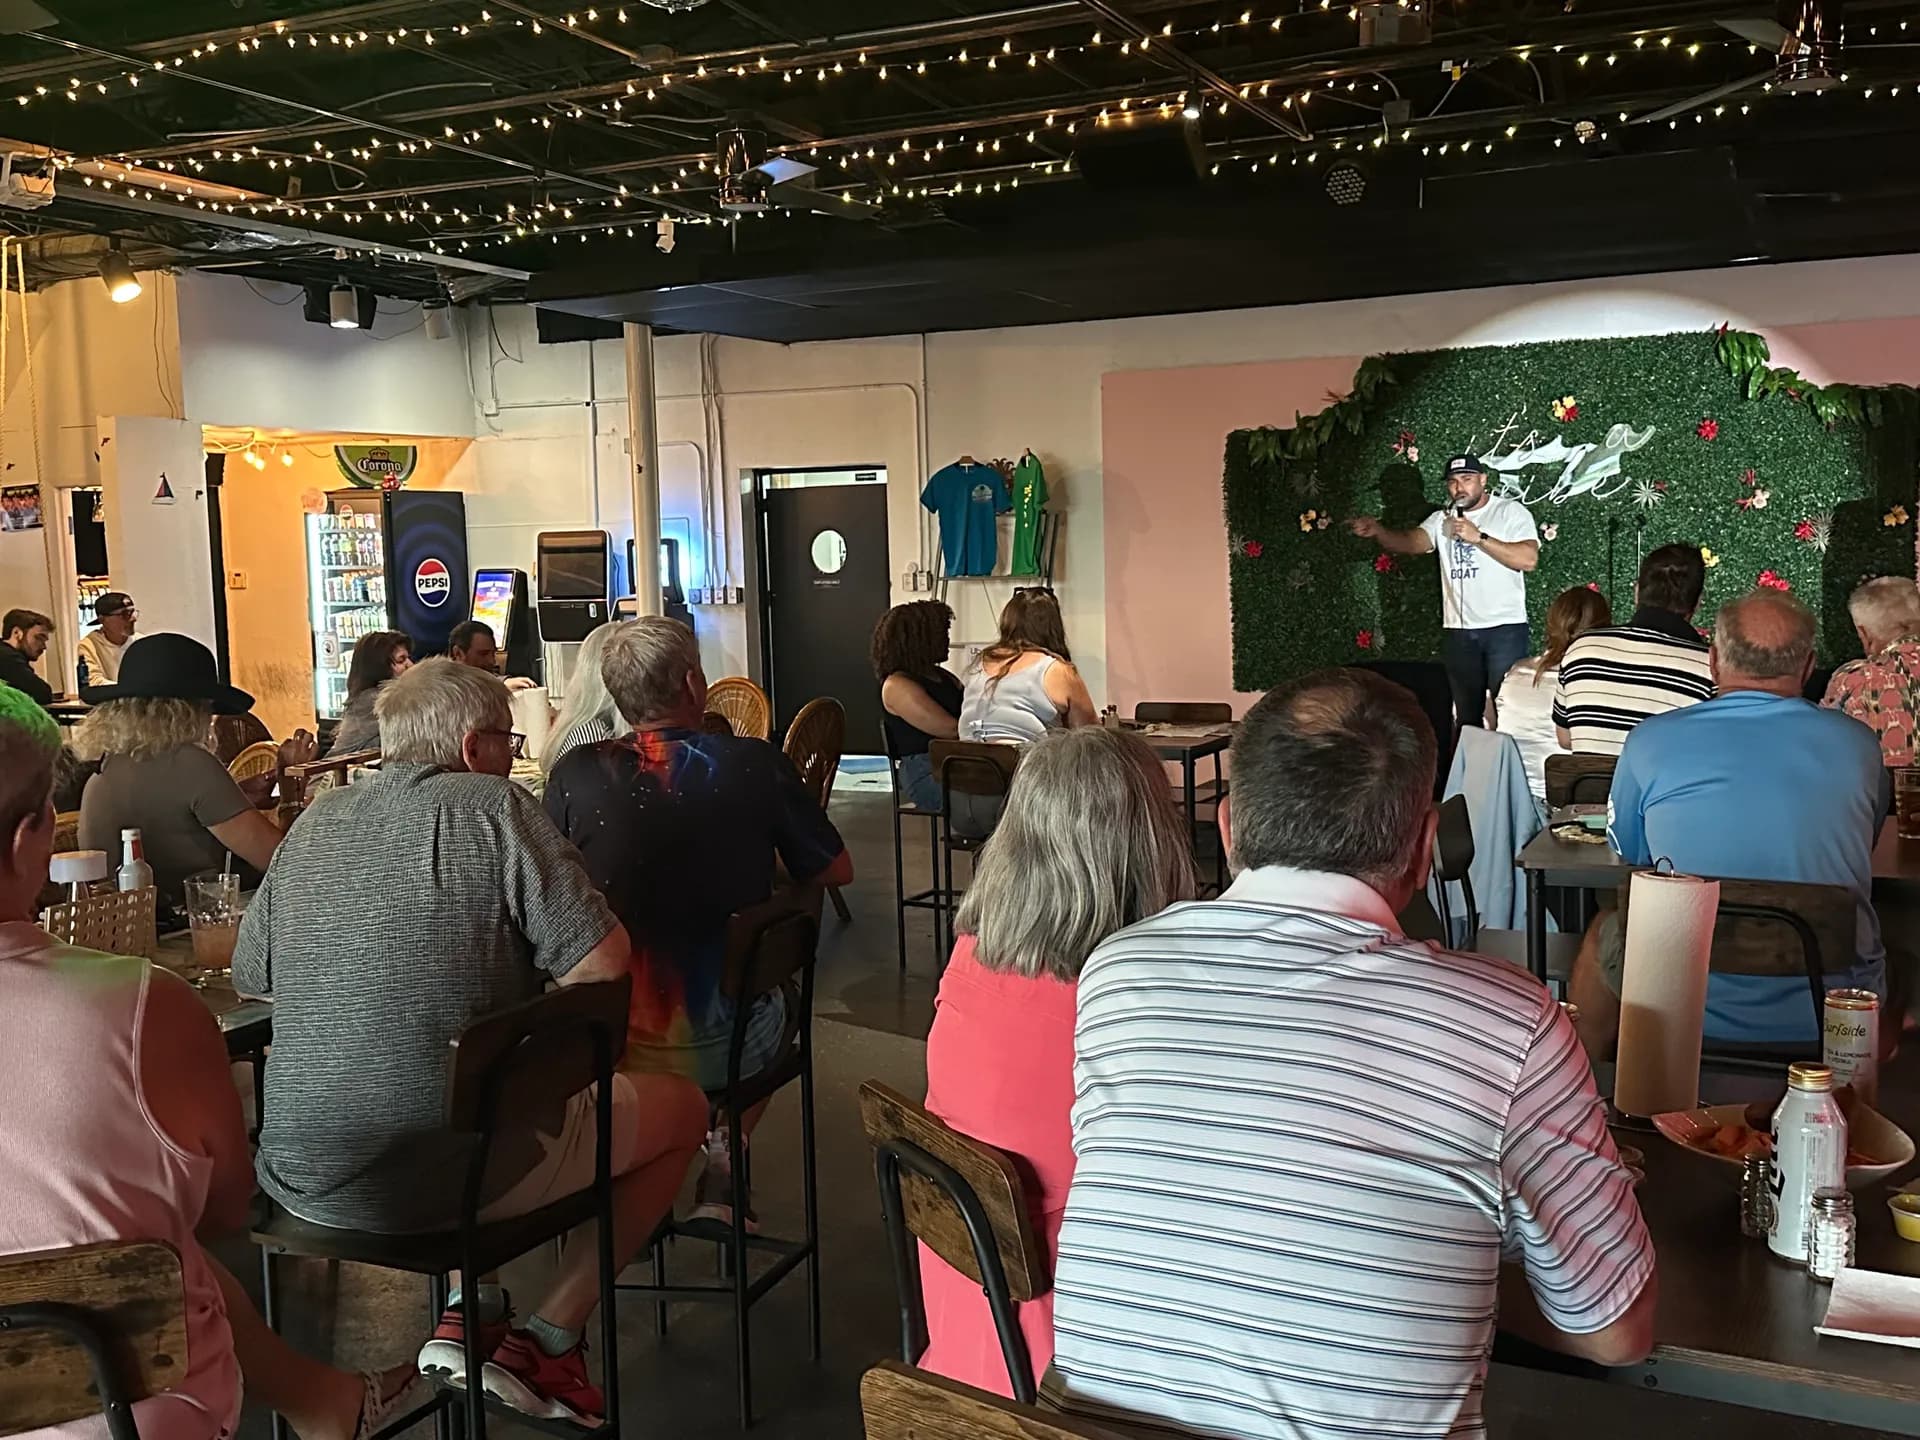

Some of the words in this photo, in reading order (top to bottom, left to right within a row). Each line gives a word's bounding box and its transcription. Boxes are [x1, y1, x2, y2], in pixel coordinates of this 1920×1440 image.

[357, 457, 403, 473] Corona
[1450, 567, 1480, 580] GOAT
[417, 577, 448, 588] PEPSI
